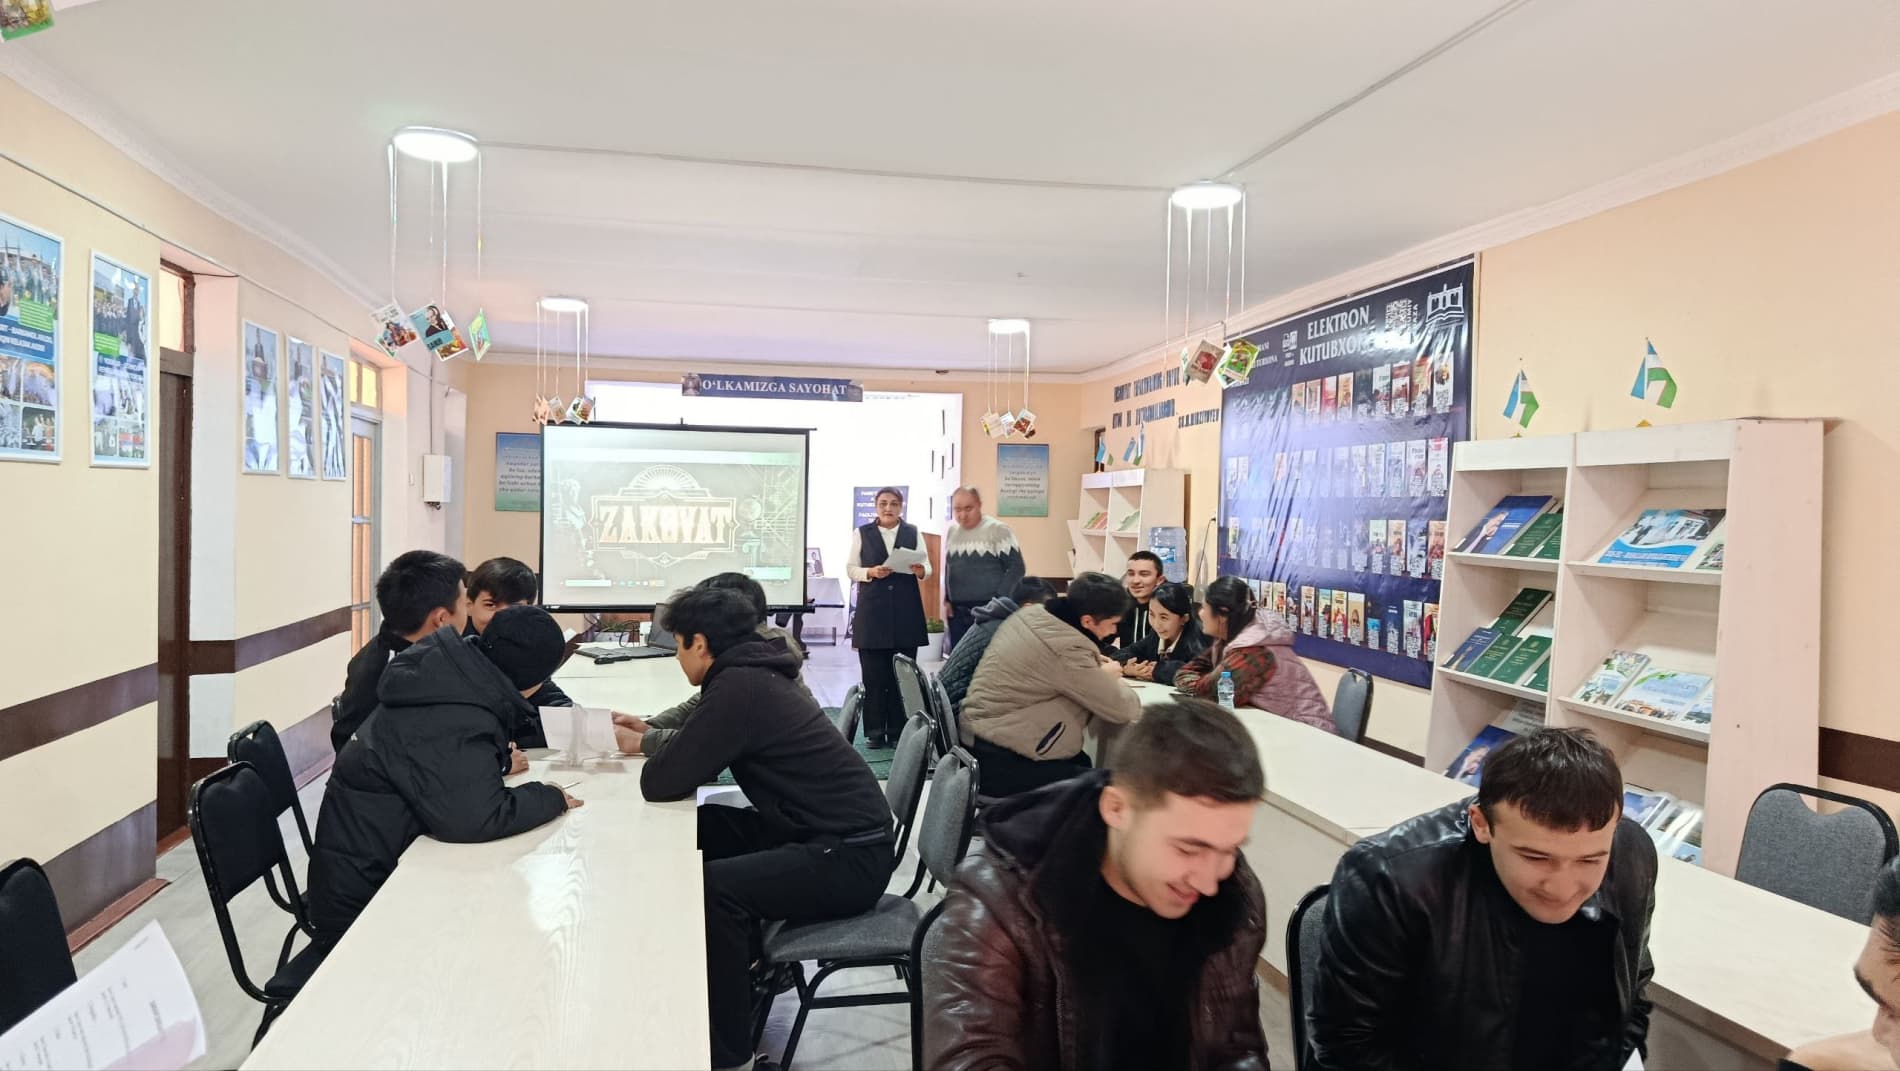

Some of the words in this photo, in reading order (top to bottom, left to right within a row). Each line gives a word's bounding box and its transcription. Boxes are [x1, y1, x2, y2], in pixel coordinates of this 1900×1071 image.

[1307, 305, 1370, 340] ELEKTRON
[788, 382, 847, 395] SAYOHAT
[599, 504, 733, 544] ZAKOVAT
